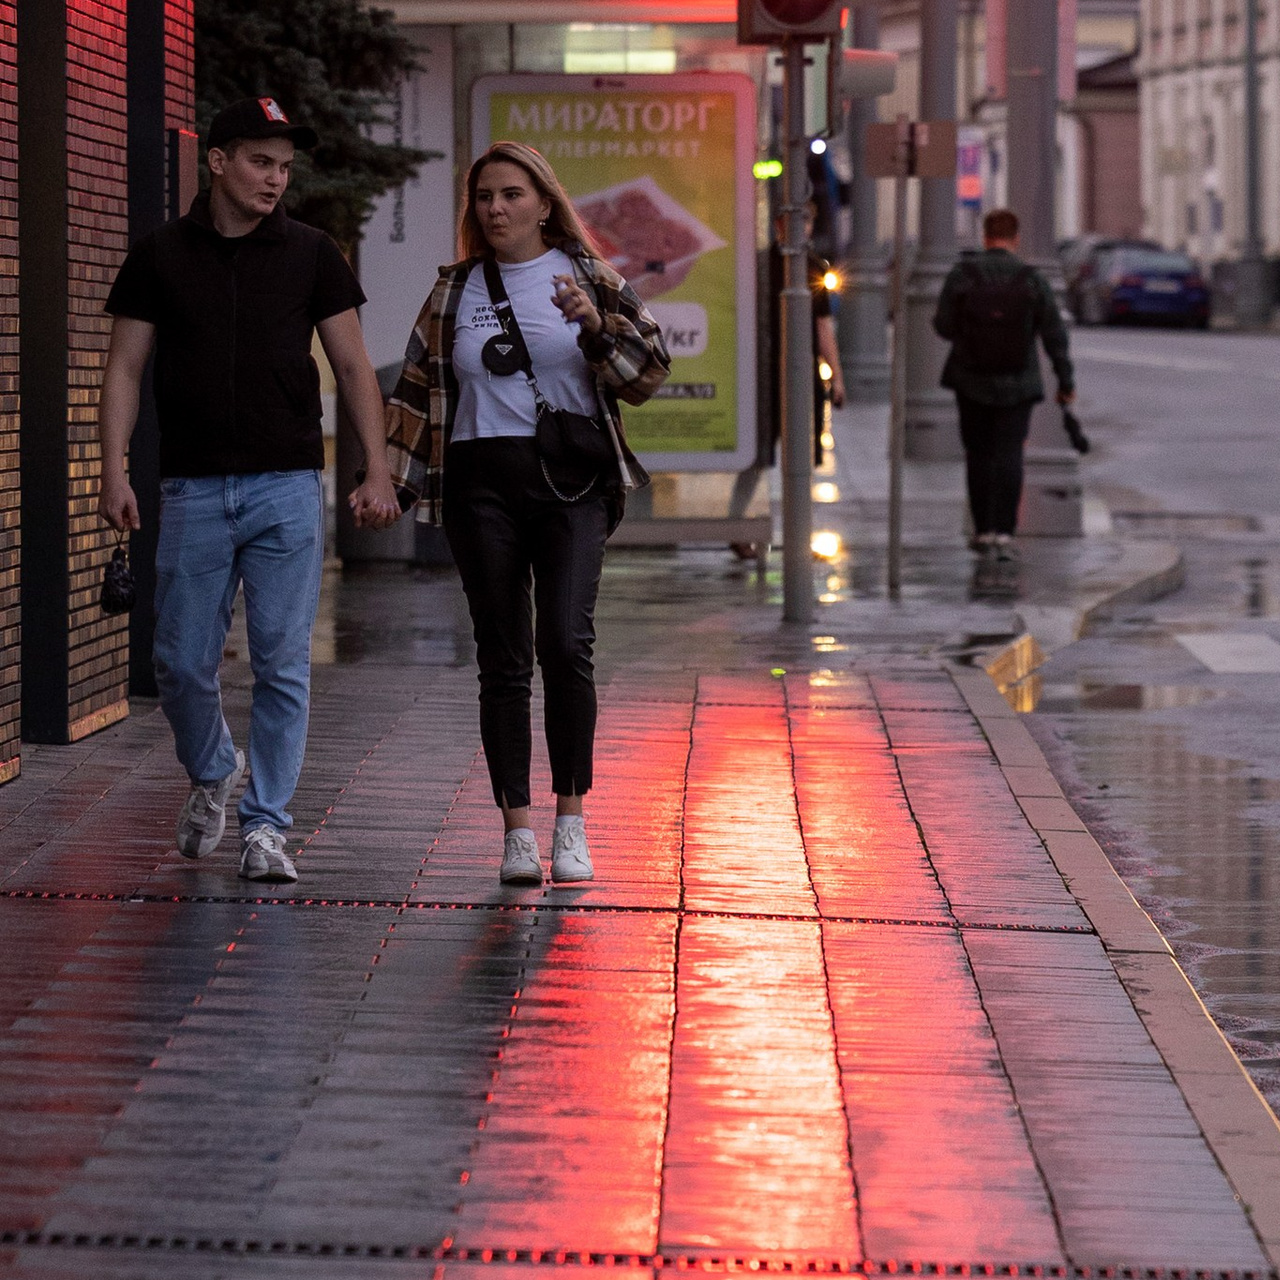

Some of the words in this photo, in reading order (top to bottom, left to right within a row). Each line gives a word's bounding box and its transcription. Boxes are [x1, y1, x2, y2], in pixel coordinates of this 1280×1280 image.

[507, 100, 717, 133] МИРАТОРГ
[526, 140, 701, 159] УПЕРМАРКЕТ
[472, 314, 498, 323] бока
